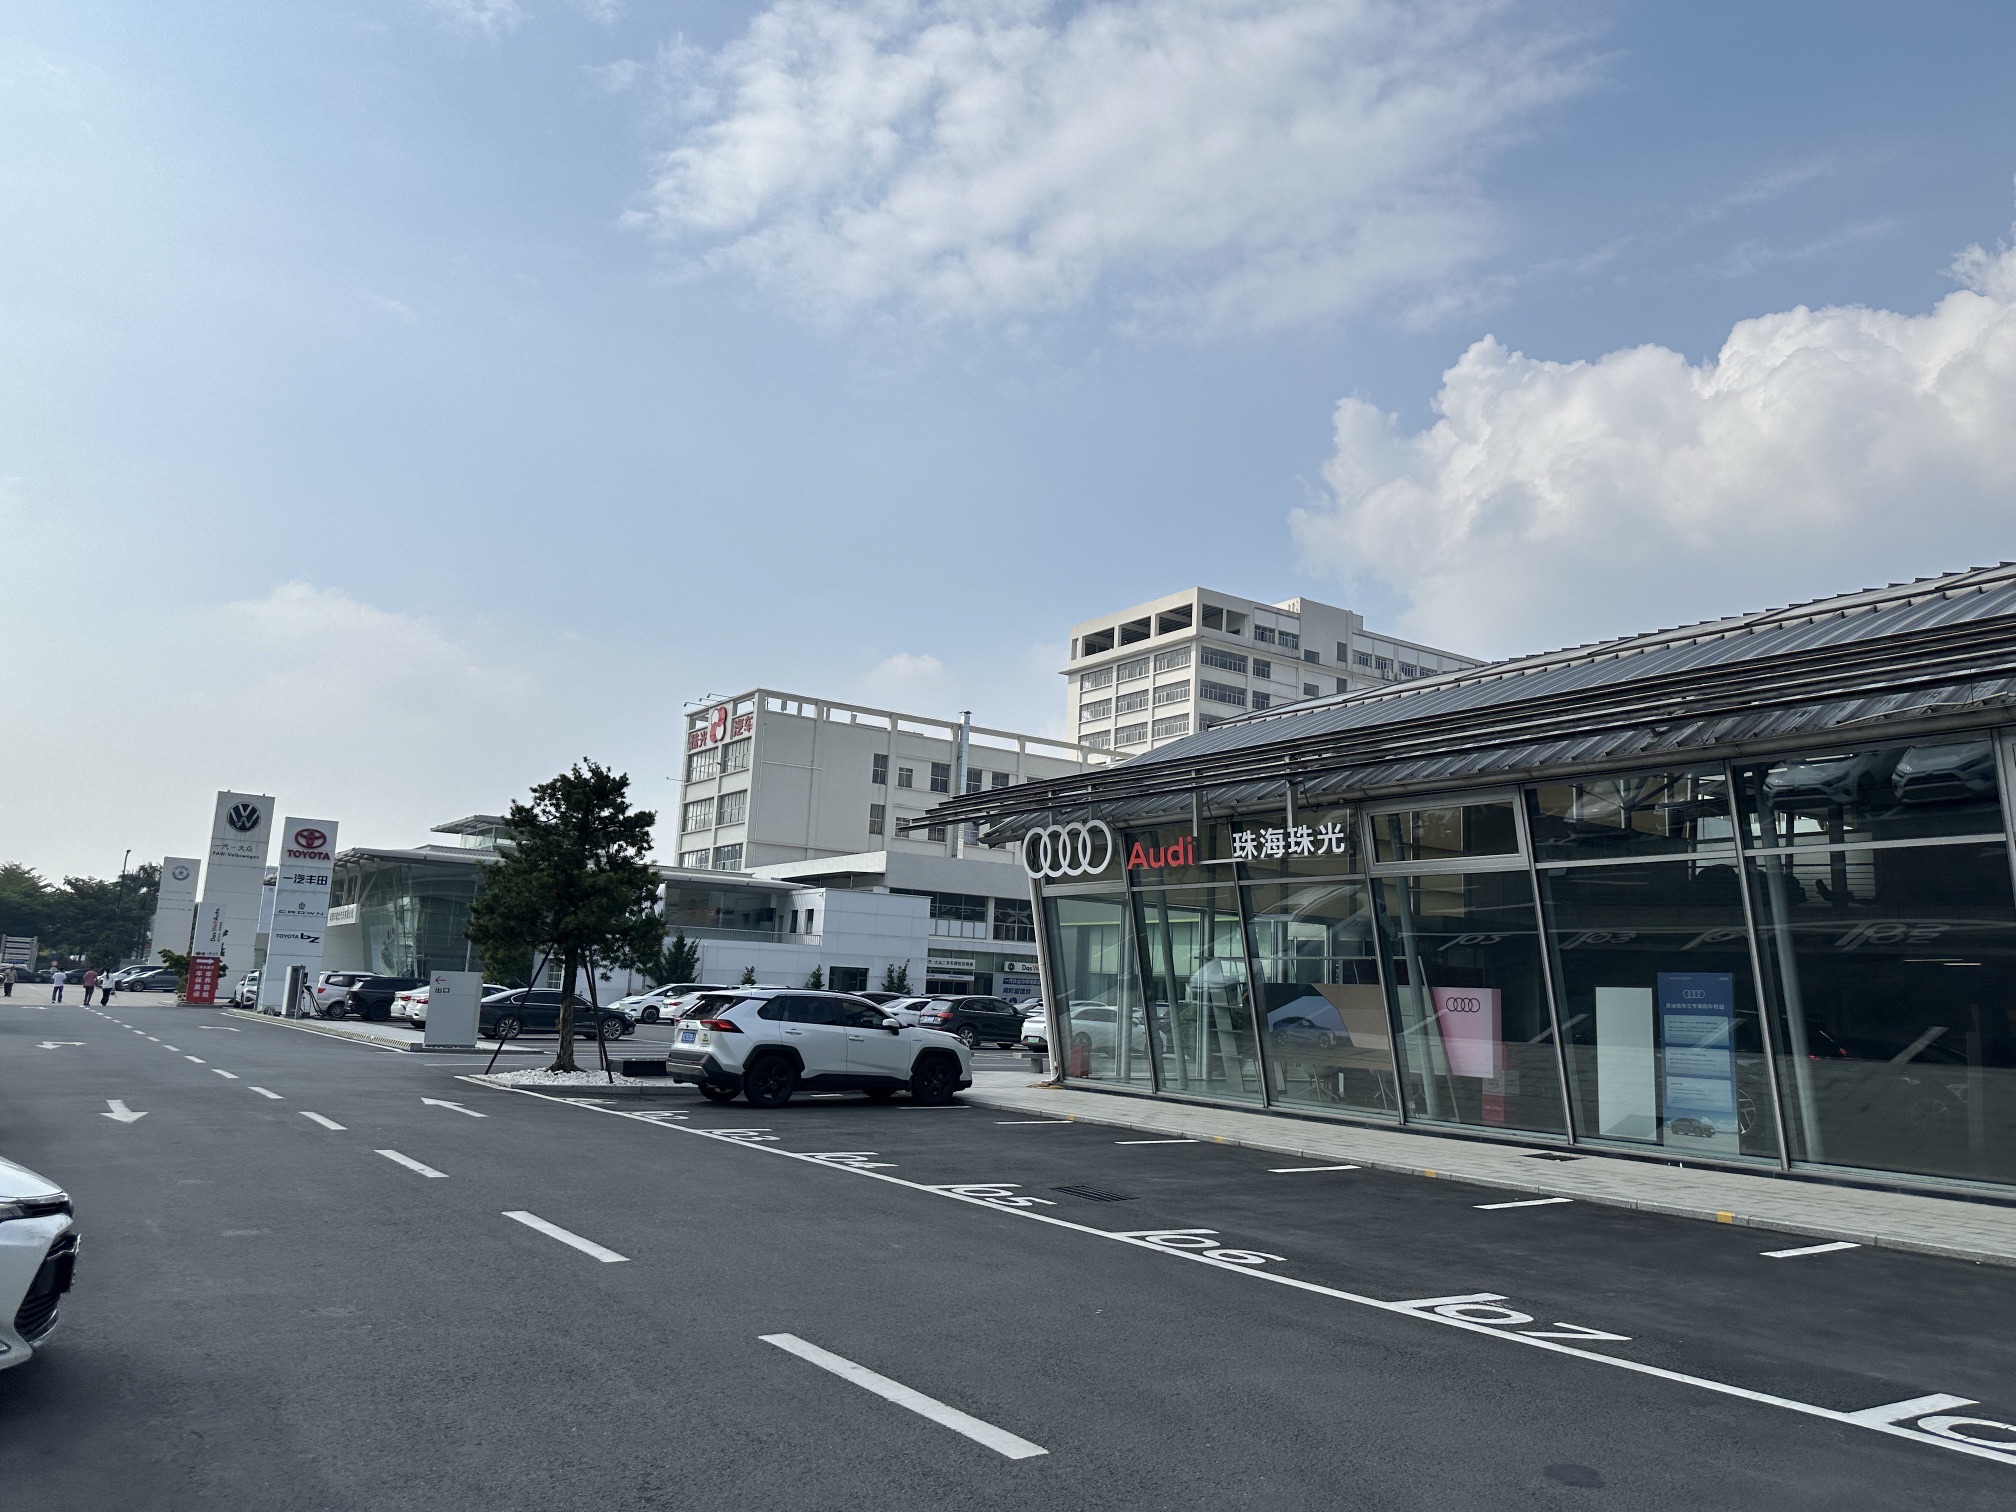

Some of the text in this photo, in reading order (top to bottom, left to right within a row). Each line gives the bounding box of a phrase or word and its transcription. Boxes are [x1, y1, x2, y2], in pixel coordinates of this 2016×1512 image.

[1232, 822, 1346, 860] 珠海珠光
[212, 850, 260, 860] FAW-Volkswagen
[286, 849, 331, 861] TOYOTA
[1127, 835, 1196, 869] Audi
[282, 873, 328, 886] 一汽丰田
[1021, 964, 1033, 972] Das
[434, 986, 451, 994] 出口
[711, 1129, 781, 1141] 03
[812, 1151, 899, 1169] 04
[950, 1186, 1058, 1207] 05
[1144, 1232, 1288, 1264] 06
[1433, 1302, 1632, 1341] 07
